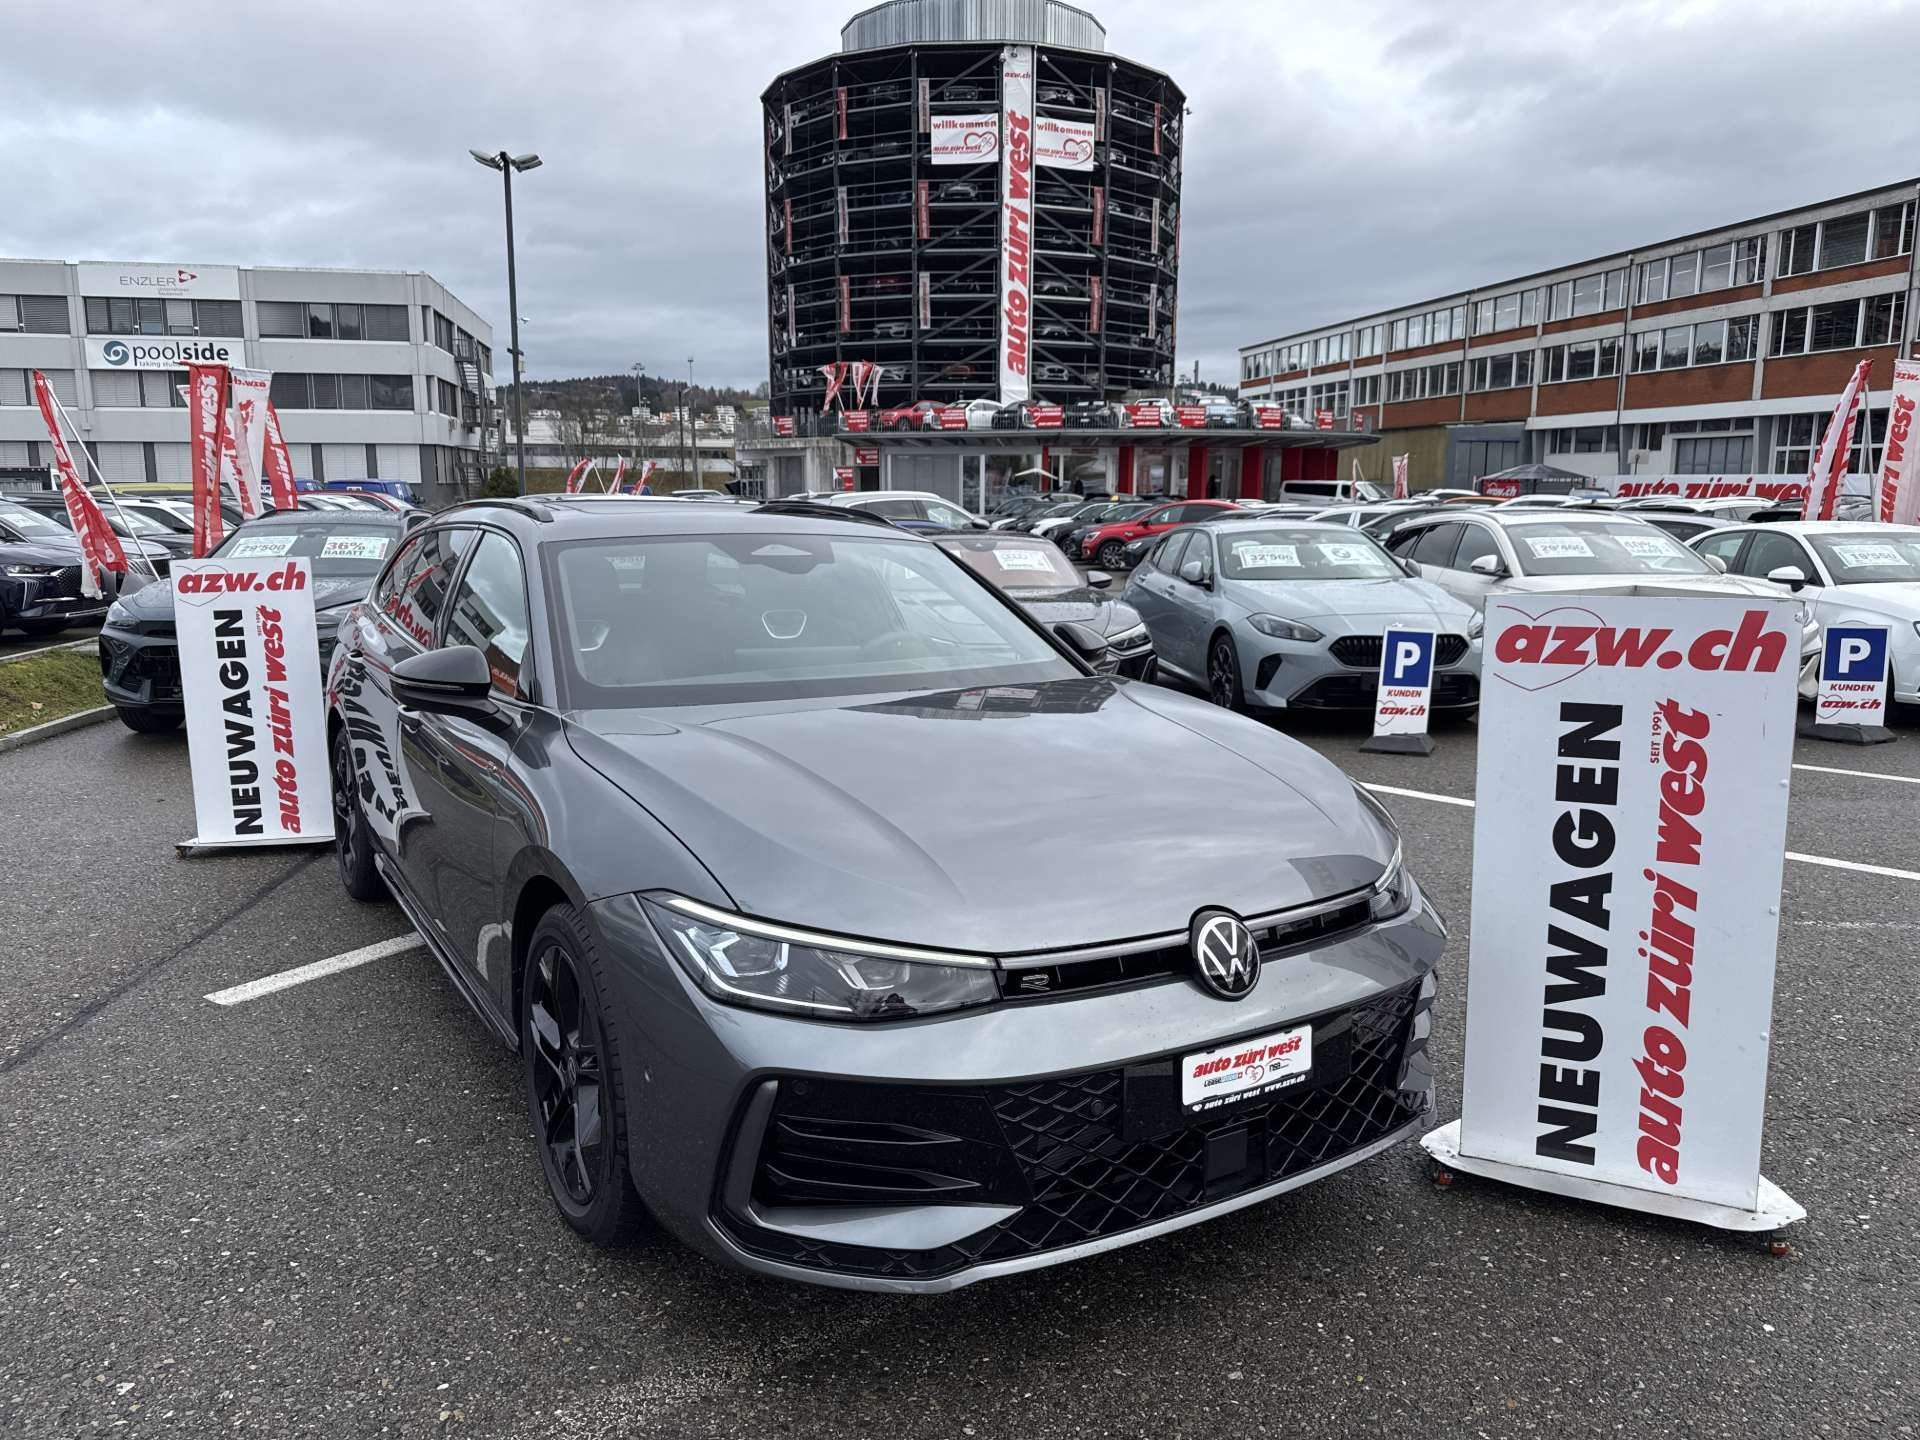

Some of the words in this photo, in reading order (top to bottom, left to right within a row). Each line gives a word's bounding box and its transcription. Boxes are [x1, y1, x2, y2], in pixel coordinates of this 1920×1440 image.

[933, 120, 997, 130] willkommen
[1037, 123, 1093, 137] willkommen
[1006, 110, 1031, 200] west
[1003, 203, 1030, 286] züri
[119, 275, 176, 287] ENZLER
[1004, 289, 1029, 376] auto
[133, 342, 229, 367] poolside
[200, 374, 219, 433] west
[1887, 394, 1916, 462] west
[1616, 477, 1680, 498] auto
[1685, 477, 1753, 499] züri
[327, 542, 366, 551] 36%
[178, 562, 306, 594] azw.ch
[256, 605, 290, 683] west
[1394, 641, 1421, 679] P
[1494, 610, 1790, 673] azw.ch
[1838, 638, 1872, 674] P
[1387, 689, 1422, 698] KUNDEN
[1821, 699, 1882, 710] azw.ch
[1830, 684, 1876, 692] KUNDEN
[213, 609, 264, 836] NEUWAGEN
[263, 686, 295, 758] züri
[1379, 705, 1426, 716] azw.ch
[1651, 709, 1664, 738] 1991
[1650, 740, 1662, 764] SEIT
[272, 759, 302, 834] auto
[1655, 698, 1711, 866] west
[1535, 702, 1624, 1166] NEUWAGEN
[1638, 868, 1698, 1028] züri
[1193, 1057, 1232, 1079] auto
[1232, 1045, 1267, 1069] züri
[1268, 1036, 1303, 1057] west
[1204, 1099, 1223, 1110] auto
[1224, 1093, 1242, 1105] züri
[1243, 1088, 1261, 1099] west
[1632, 1024, 1688, 1185] auto
